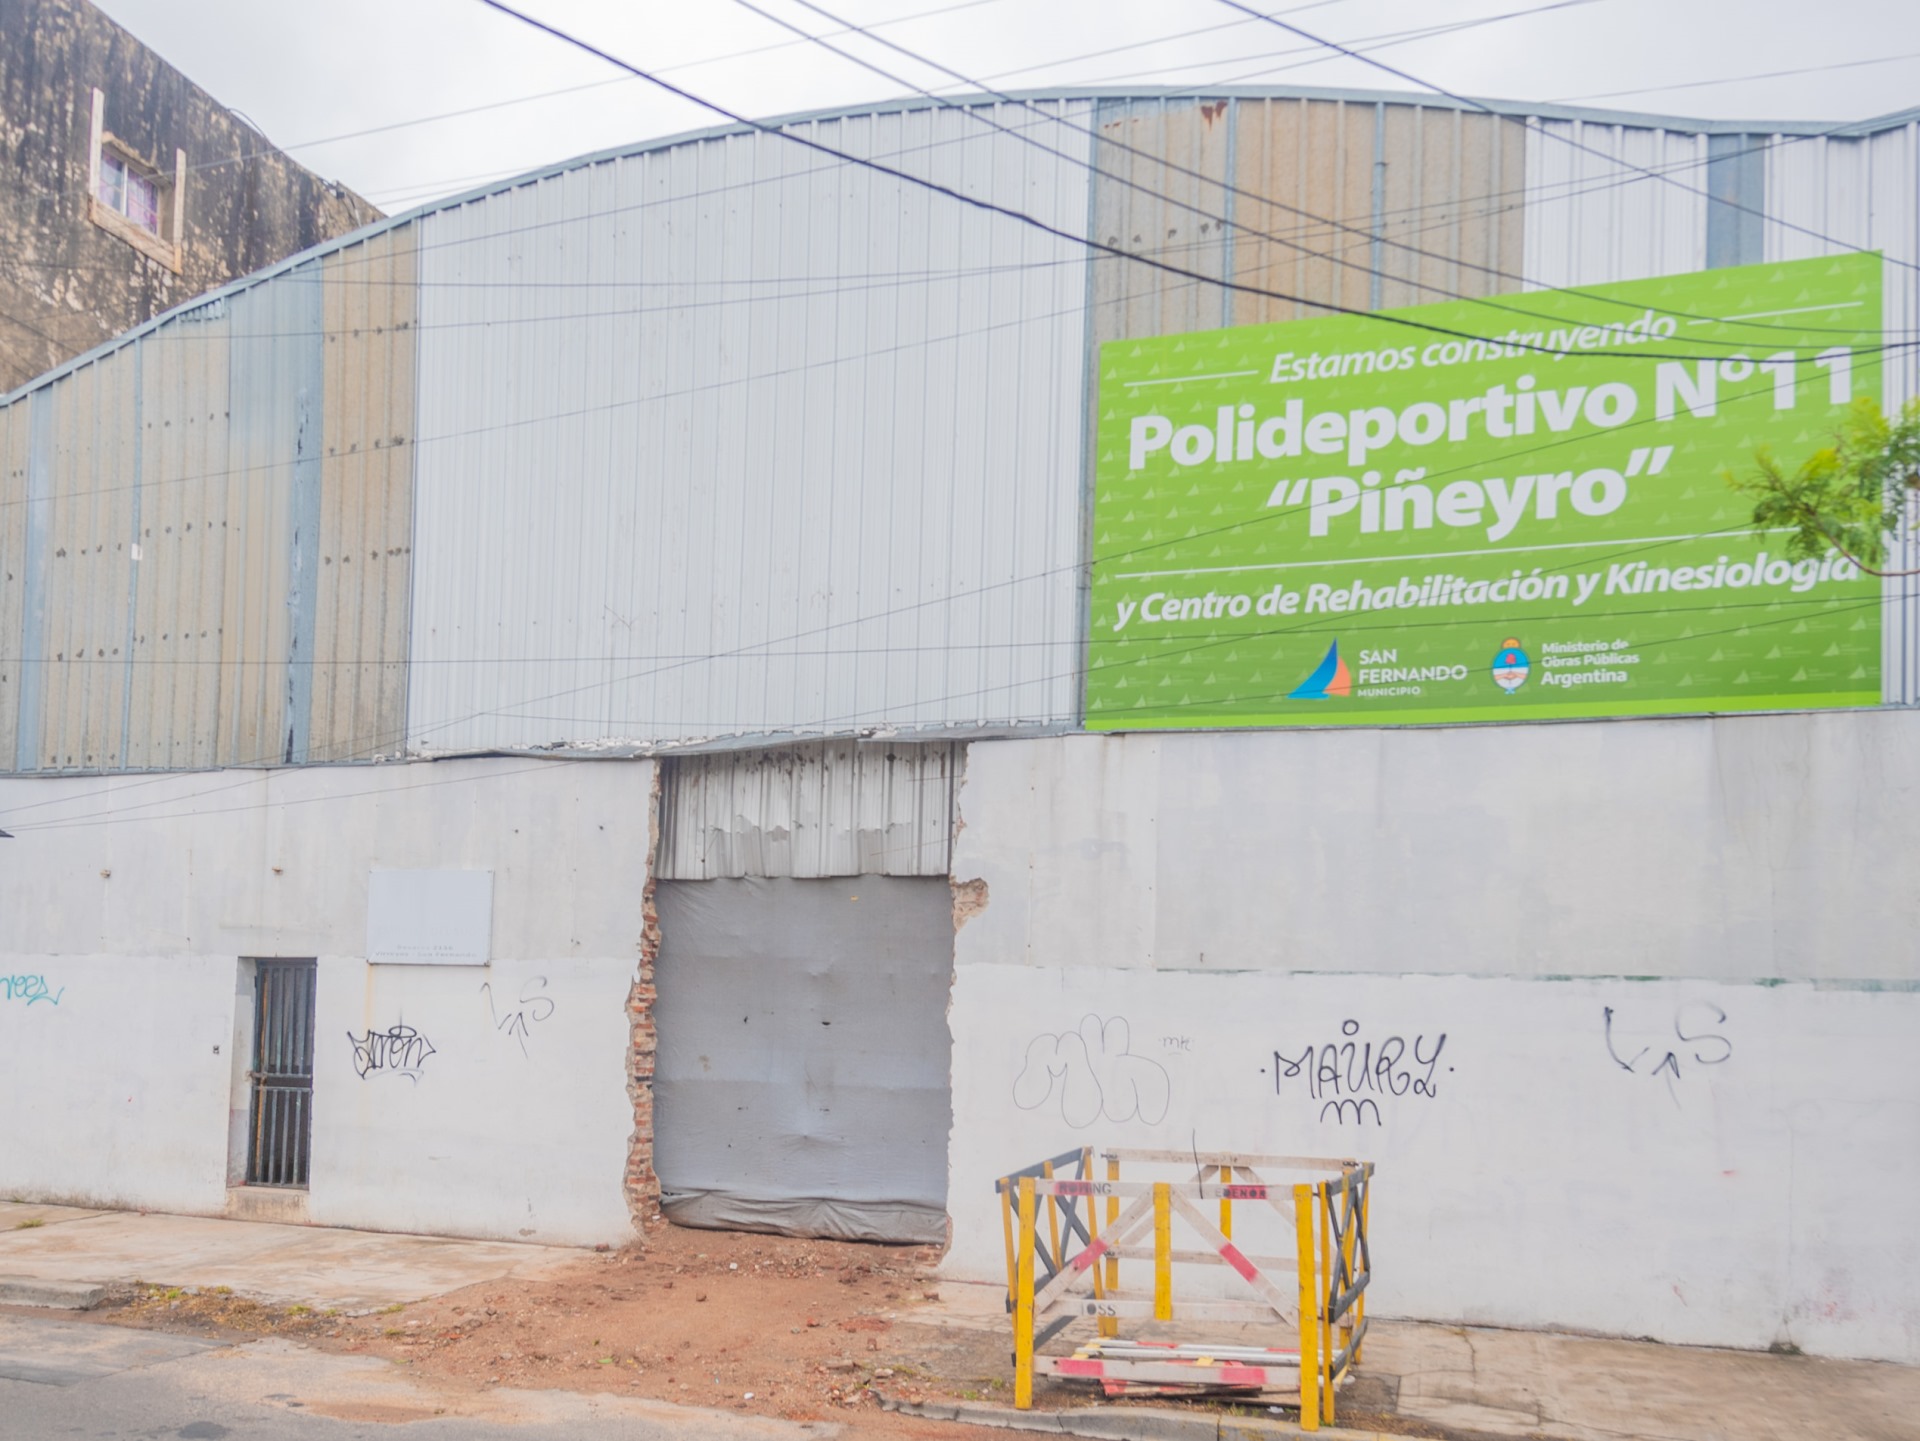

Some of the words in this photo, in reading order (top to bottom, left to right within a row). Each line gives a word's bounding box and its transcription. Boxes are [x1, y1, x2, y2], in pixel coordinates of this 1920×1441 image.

[1269, 346, 1416, 384] Estamos
[1421, 309, 1677, 362] construyendo
[1128, 374, 1639, 470] Polideportivo
[1113, 600, 1136, 632] y
[1140, 592, 1252, 622] Centro
[1256, 584, 1300, 616] de
[1304, 567, 1569, 613] Rehabilitación
[1572, 572, 1602, 607] y
[1604, 548, 1860, 596] Kinesiología
[1541, 639, 1609, 654] Ministerio
[1611, 639, 1630, 651] de
[1358, 649, 1397, 665] SAN
[1541, 655, 1584, 668] Obras
[1585, 652, 1640, 666] Públicas
[1358, 664, 1468, 685] FERNANDO
[1541, 668, 1628, 688] Argentina
[1357, 686, 1421, 697] MUNICIPIO
[1215, 1187, 1267, 1199] EDENOR
